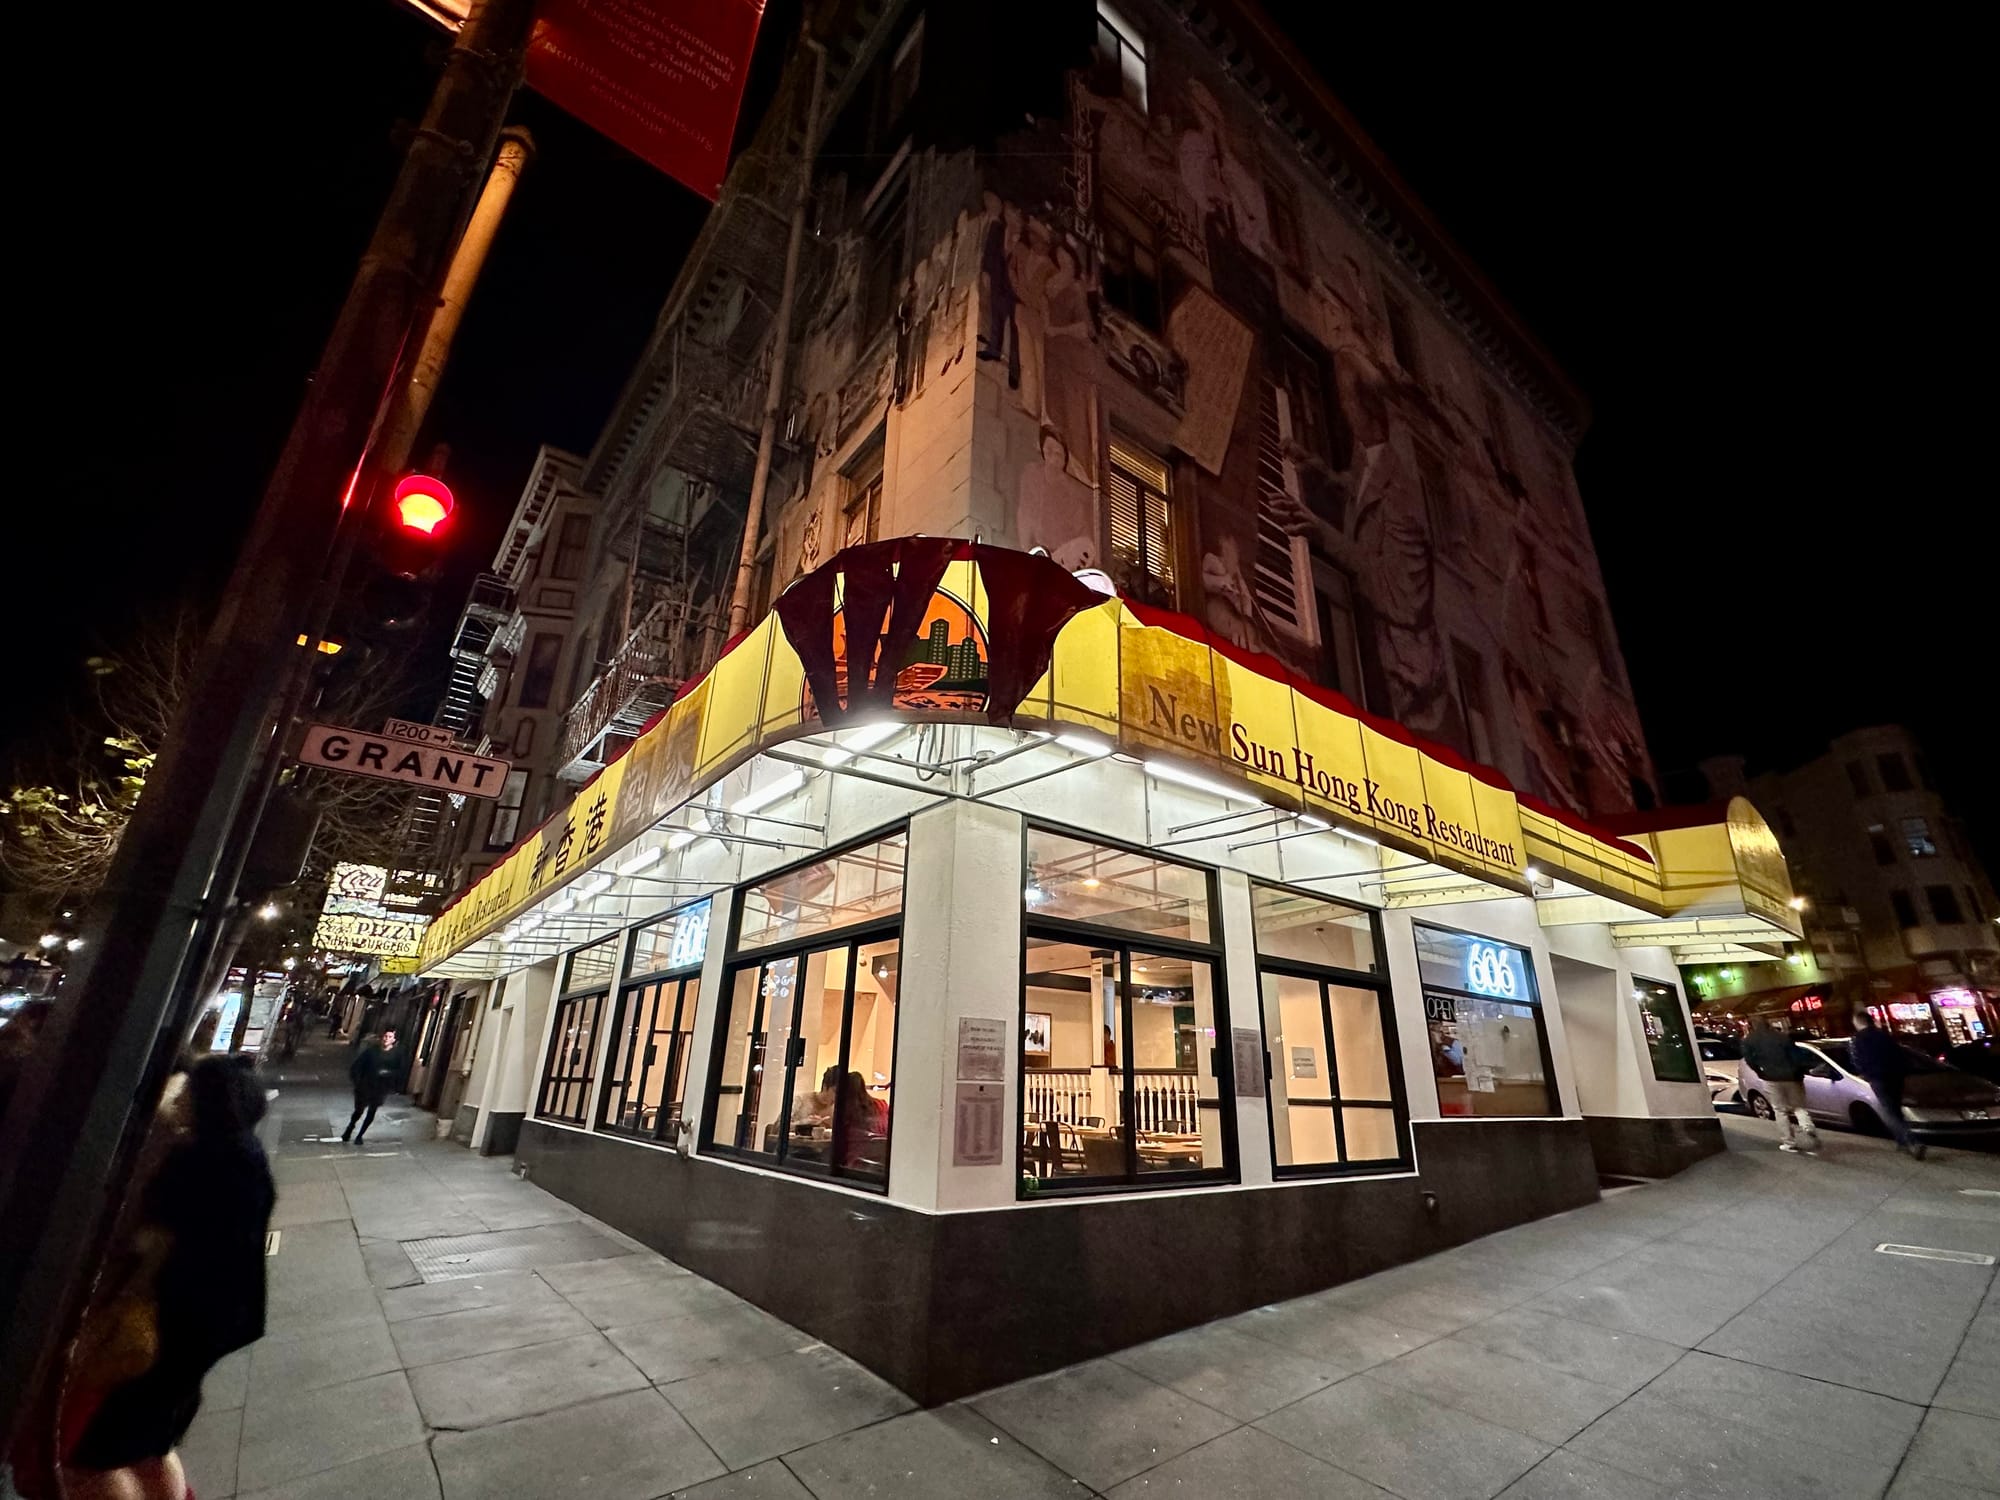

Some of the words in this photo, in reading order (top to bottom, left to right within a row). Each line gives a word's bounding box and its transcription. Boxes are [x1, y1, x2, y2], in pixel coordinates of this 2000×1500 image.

[661, 16, 736, 71] Community
[674, 40, 694, 59] for
[661, 48, 718, 91] Stability
[390, 722, 430, 741] 1200
[320, 735, 494, 788] GRANT
[1148, 685, 1222, 752] New
[1232, 723, 1286, 778] Sun
[1292, 747, 1361, 814] Hong
[1363, 777, 1422, 837] Kong
[1423, 803, 1517, 866] Restaurant
[473, 881, 512, 925] Restaurant
[354, 921, 417, 941] PIZZA
[1468, 942, 1515, 996] 606
[1426, 997, 1457, 1020] OPEN
